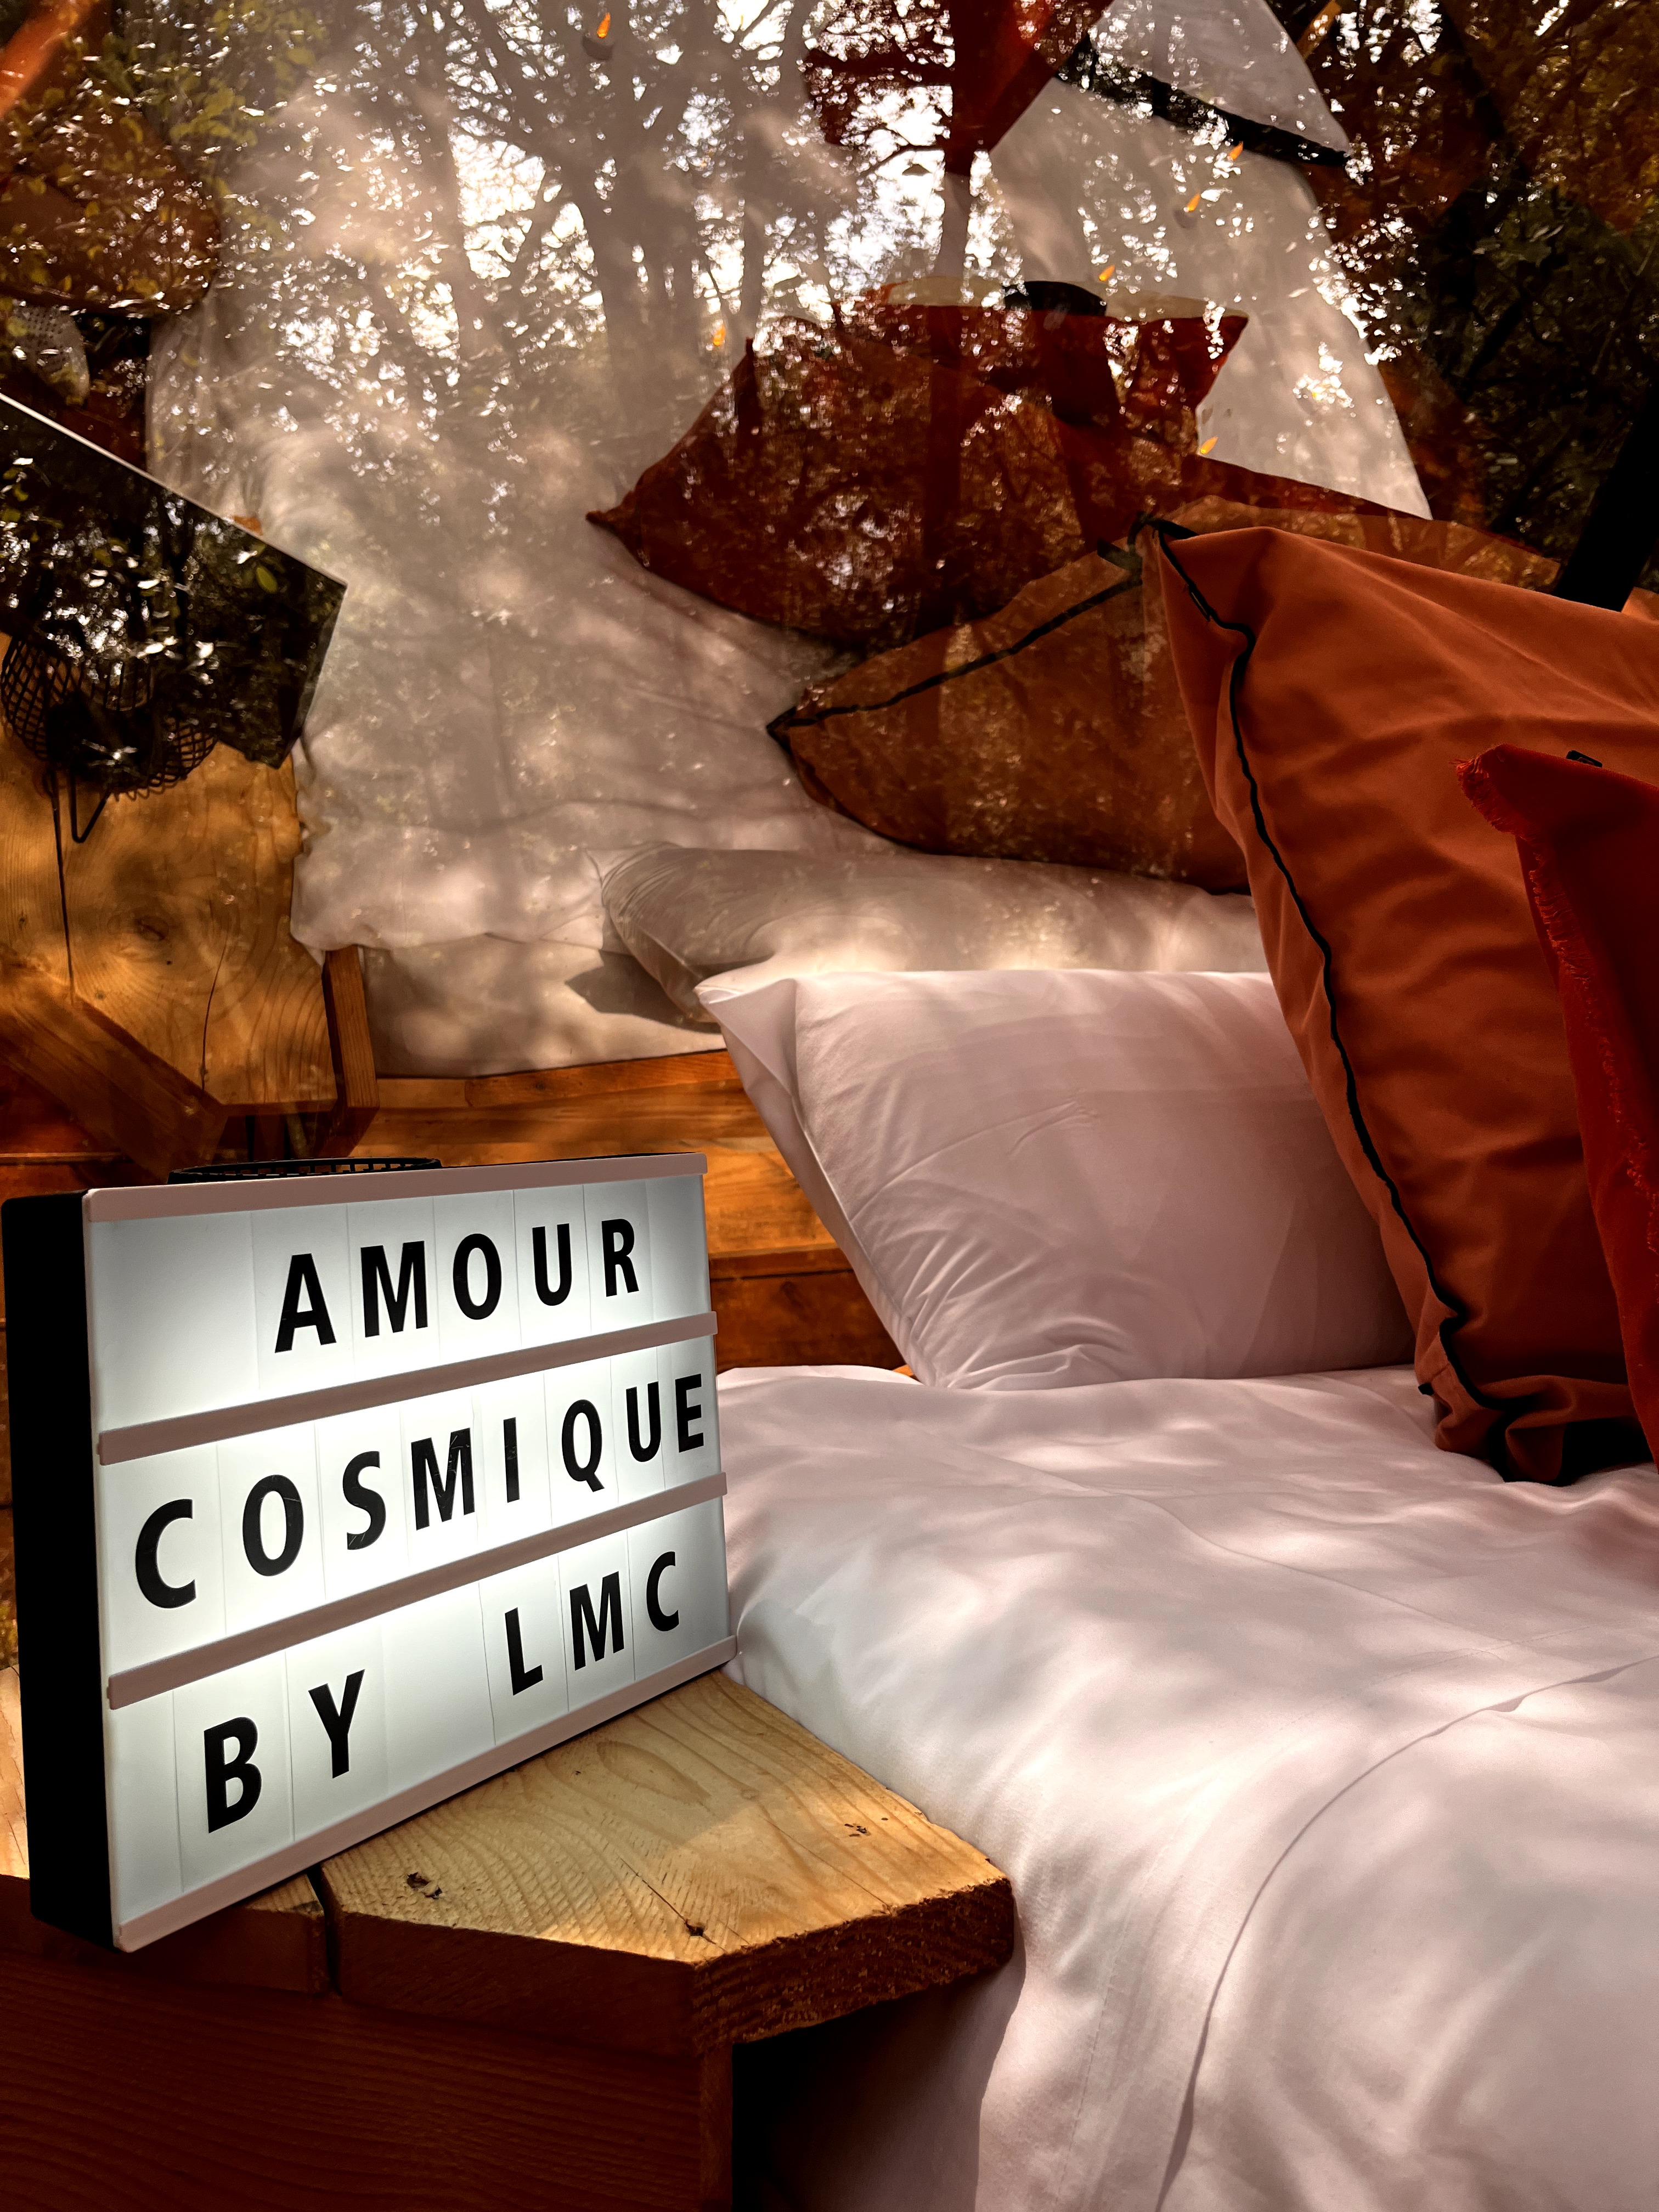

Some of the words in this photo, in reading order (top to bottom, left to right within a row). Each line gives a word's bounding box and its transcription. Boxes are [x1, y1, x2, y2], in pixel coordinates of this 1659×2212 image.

[274, 1218, 640, 1354] AMOUR
[134, 1373, 705, 1609] COSMIQUE
[203, 1669, 365, 1834] BY
[504, 1550, 680, 1696] LMC
